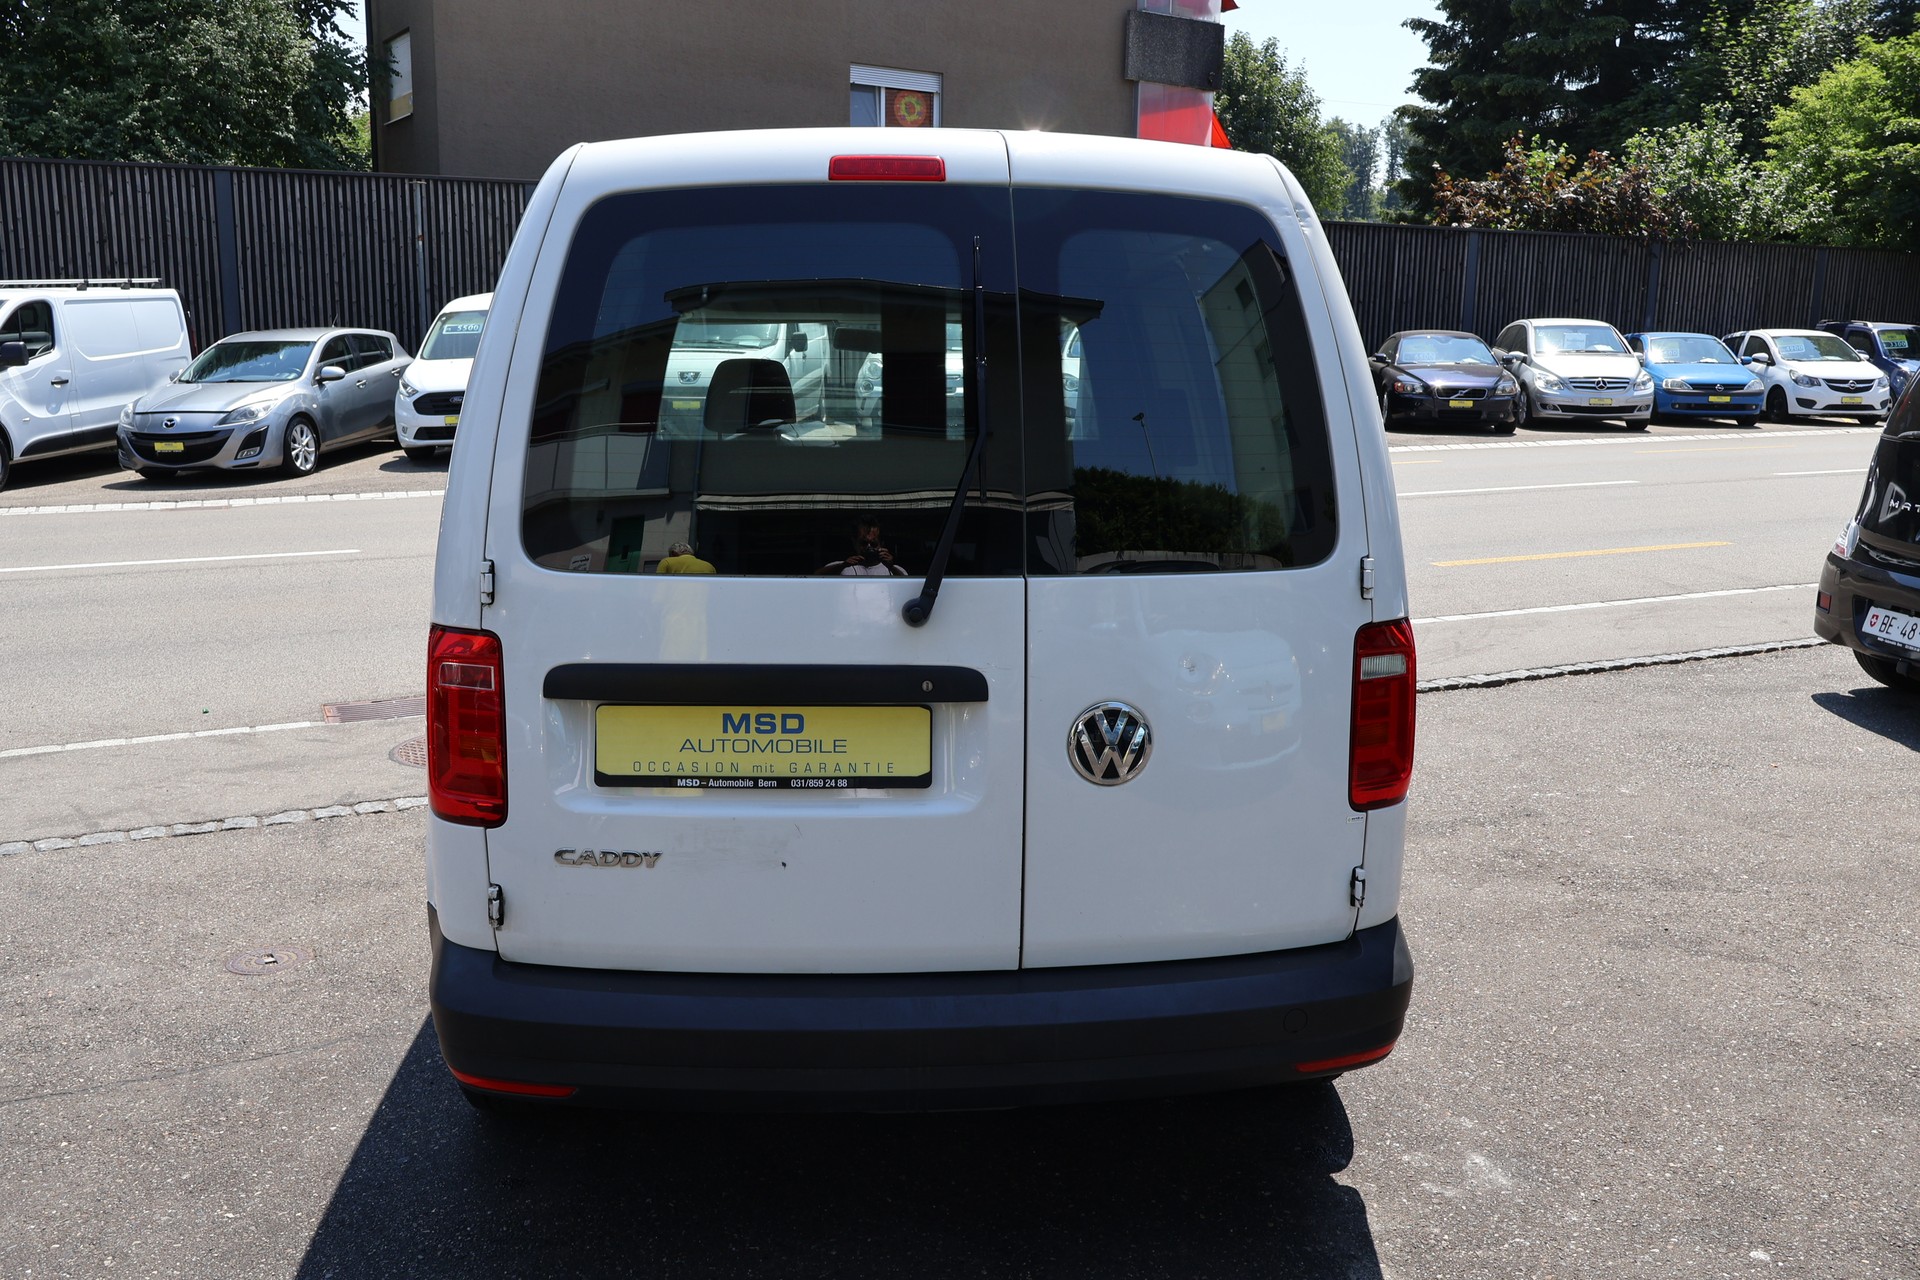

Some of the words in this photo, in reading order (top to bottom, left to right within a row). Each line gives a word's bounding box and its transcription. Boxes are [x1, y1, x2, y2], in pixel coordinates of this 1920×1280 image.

[1878, 614, 1897, 634] BE
[1899, 620, 1918, 640] 48
[722, 713, 805, 734] MSD
[679, 738, 847, 754] AUTOMOBILE
[1072, 704, 1149, 783] VW
[632, 761, 740, 774] OCCASION
[752, 761, 775, 774] mit
[789, 761, 895, 774] GARANTIE
[677, 778, 700, 787] MSD
[708, 778, 754, 787] Automobile
[758, 778, 777, 787] Bern
[791, 778, 824, 788] 031/859
[825, 779, 835, 787] 24
[837, 779, 848, 787] 88
[554, 847, 663, 869] CADDY
